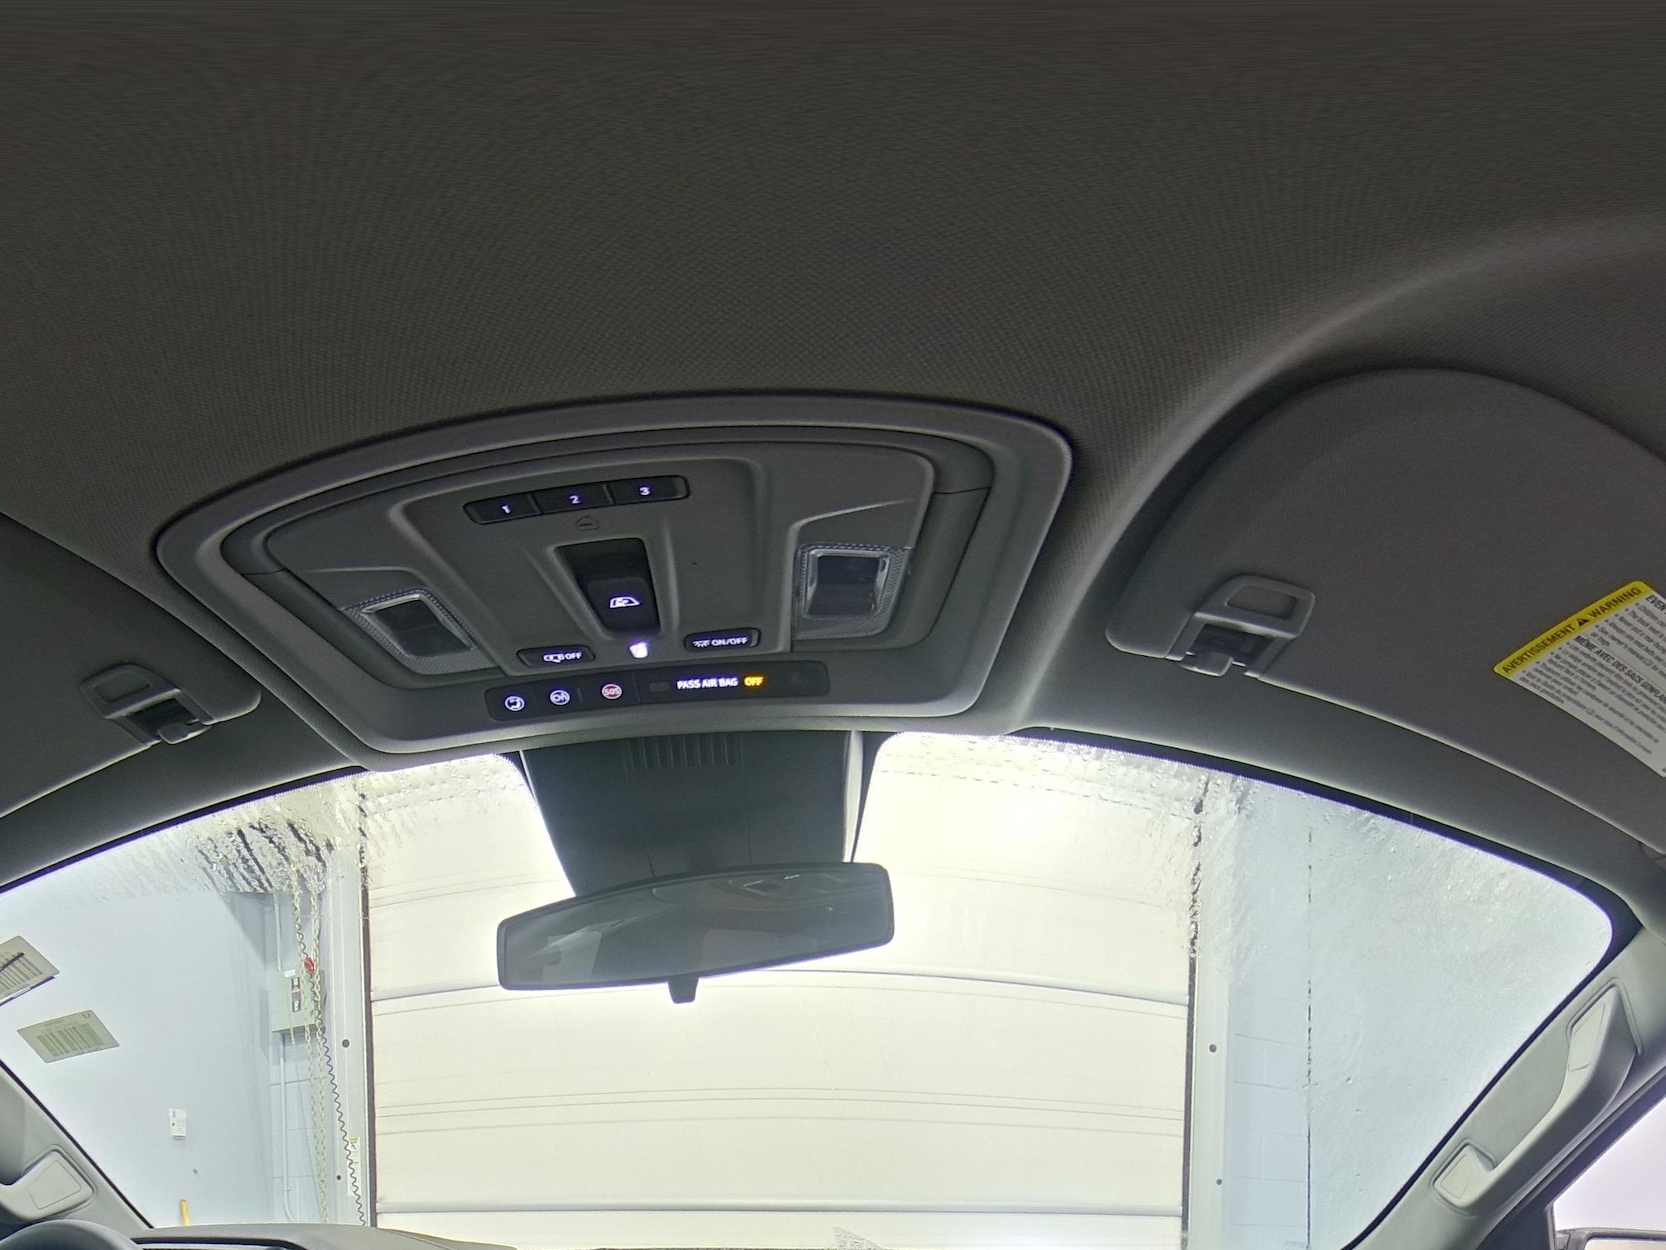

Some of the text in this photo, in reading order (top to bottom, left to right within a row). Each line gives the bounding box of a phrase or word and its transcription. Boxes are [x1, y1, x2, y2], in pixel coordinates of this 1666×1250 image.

[640, 487, 651, 495] 3
[569, 495, 580, 504] 2
[1502, 625, 1575, 674] AVERTISSEMENT
[1589, 587, 1641, 619] WARNING
[712, 637, 748, 646] ON/OFF
[565, 652, 581, 660] OFF
[1593, 647, 1616, 663] AVEC
[1610, 659, 1629, 672] DES
[1623, 669, 1645, 684] SACS
[677, 677, 763, 690] PASS AIR BAG OFF
